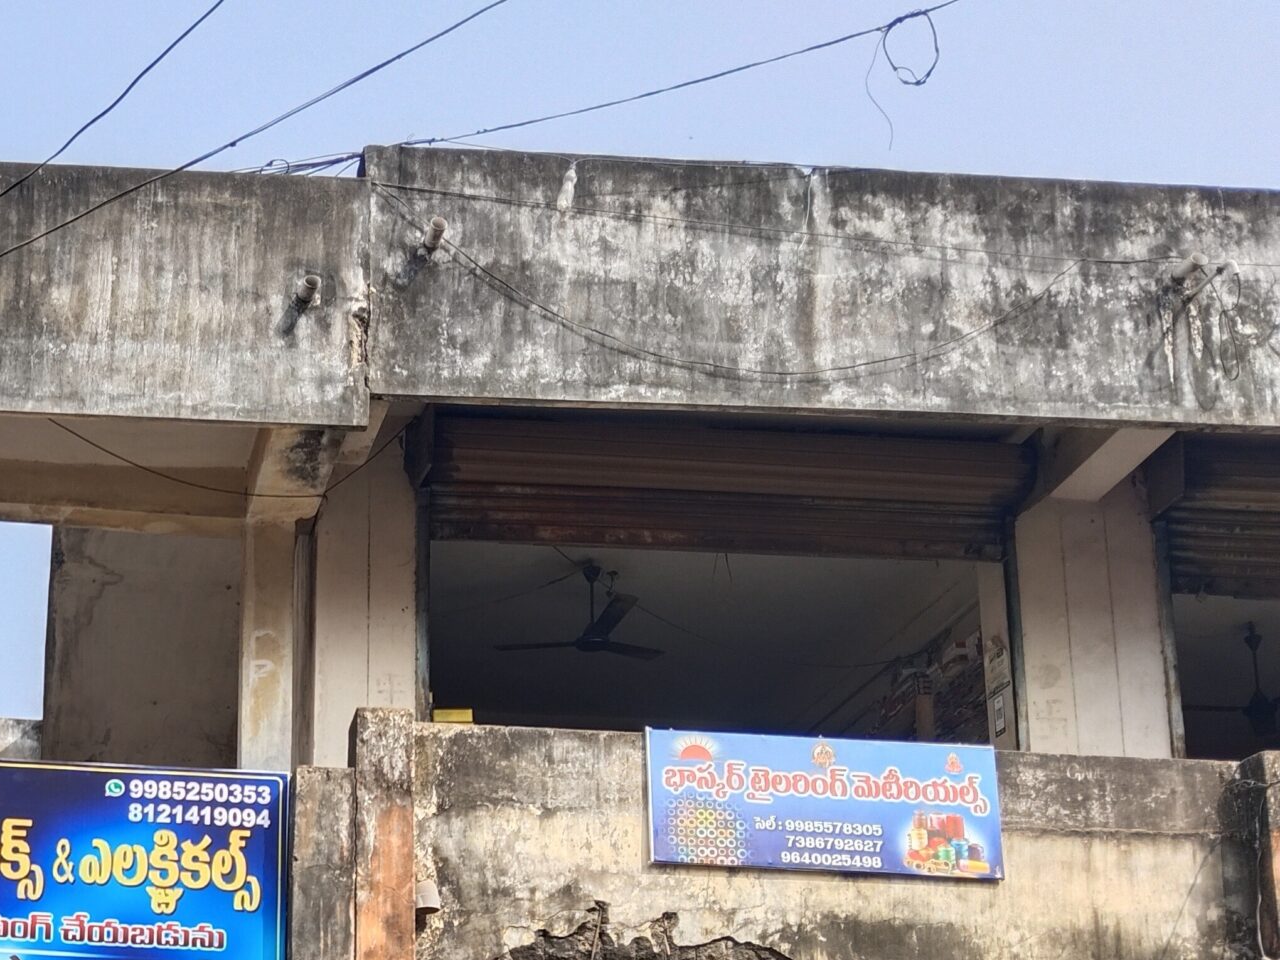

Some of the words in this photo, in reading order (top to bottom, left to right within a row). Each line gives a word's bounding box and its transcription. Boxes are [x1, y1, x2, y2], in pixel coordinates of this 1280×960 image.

[129, 779, 271, 805] 9985250353
[663, 763, 746, 799] భాస్కర్
[747, 768, 848, 803] టైలరింగ్
[853, 768, 989, 816] మెటీరియల్స్
[128, 803, 271, 828] 8121419094
[785, 820, 882, 836] 9985578305
[786, 836, 883, 852] 7386792627
[52, 838, 75, 884] &
[782, 852, 882, 868] 9640025498
[60, 916, 227, 951] చేయబడును
